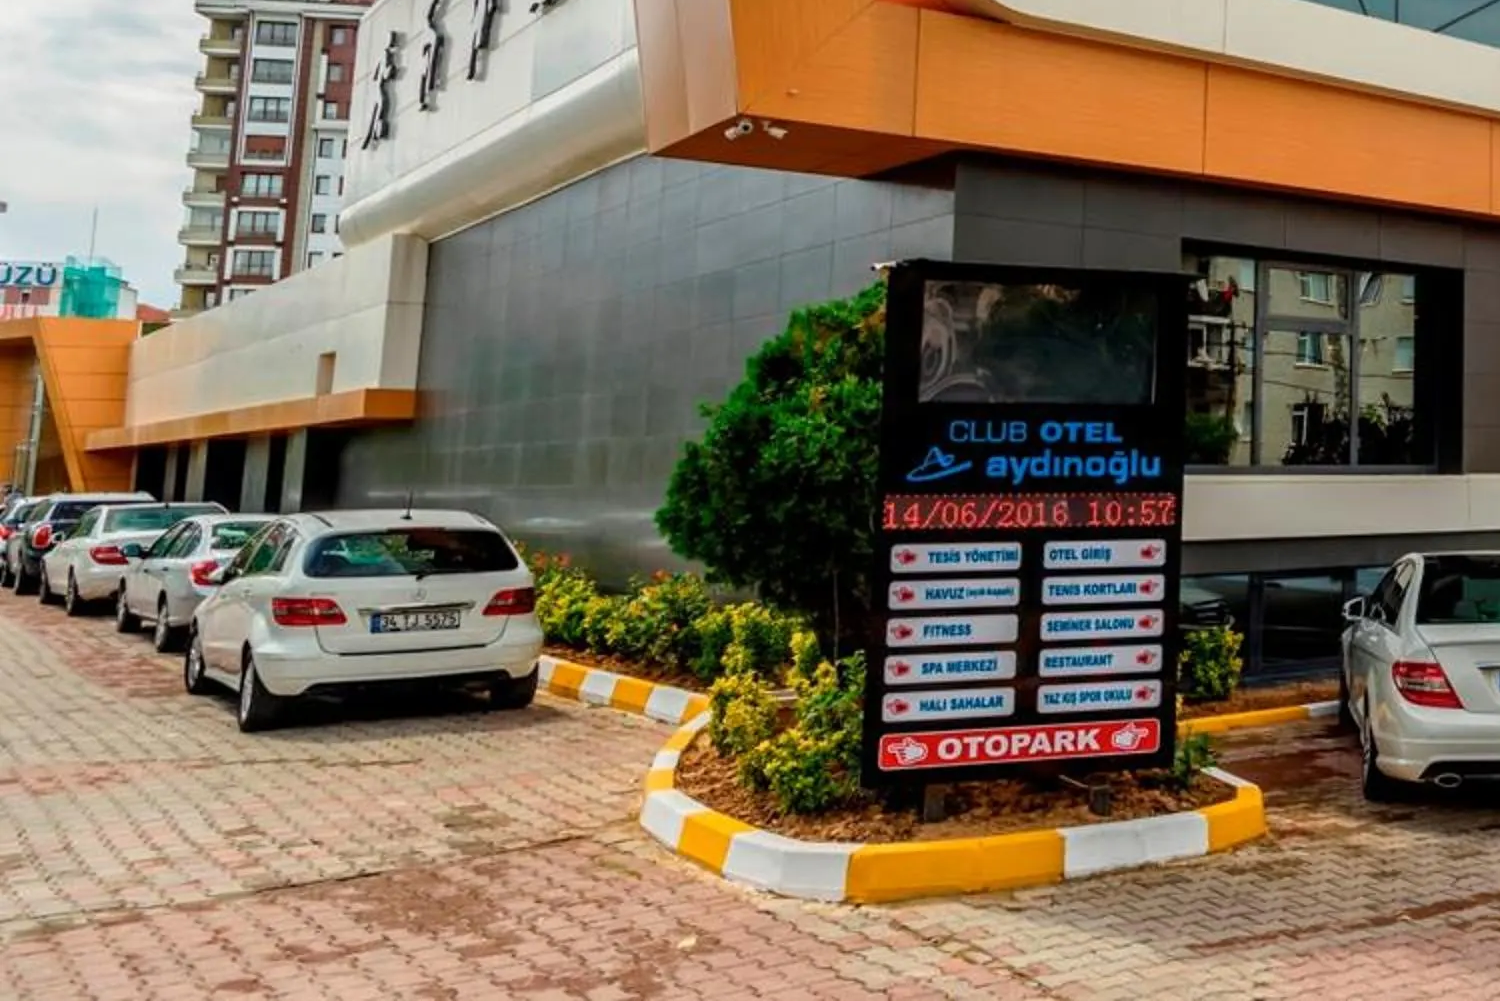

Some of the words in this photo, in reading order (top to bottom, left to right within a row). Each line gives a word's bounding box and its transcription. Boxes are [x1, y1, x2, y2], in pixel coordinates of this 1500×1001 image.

[950, 421, 1027, 442] CLUB
[1039, 422, 1123, 442] OTEL
[986, 449, 1161, 485] aydınoğlu
[885, 502, 1069, 528] 14/06/2016
[1088, 500, 1176, 526] 10:57
[1049, 548, 1079, 560] OTEL
[925, 587, 964, 600] HAVUZ
[1083, 582, 1137, 595] KORTLARI
[1094, 617, 1135, 630] SALONU
[1044, 654, 1114, 668] RESTAURANT
[921, 662, 943, 675] SPA
[949, 694, 1004, 710] SAHALAR
[1079, 689, 1102, 703] SPOR
[1103, 688, 1132, 701] OKULU
[937, 728, 1101, 760] OTOPARK
